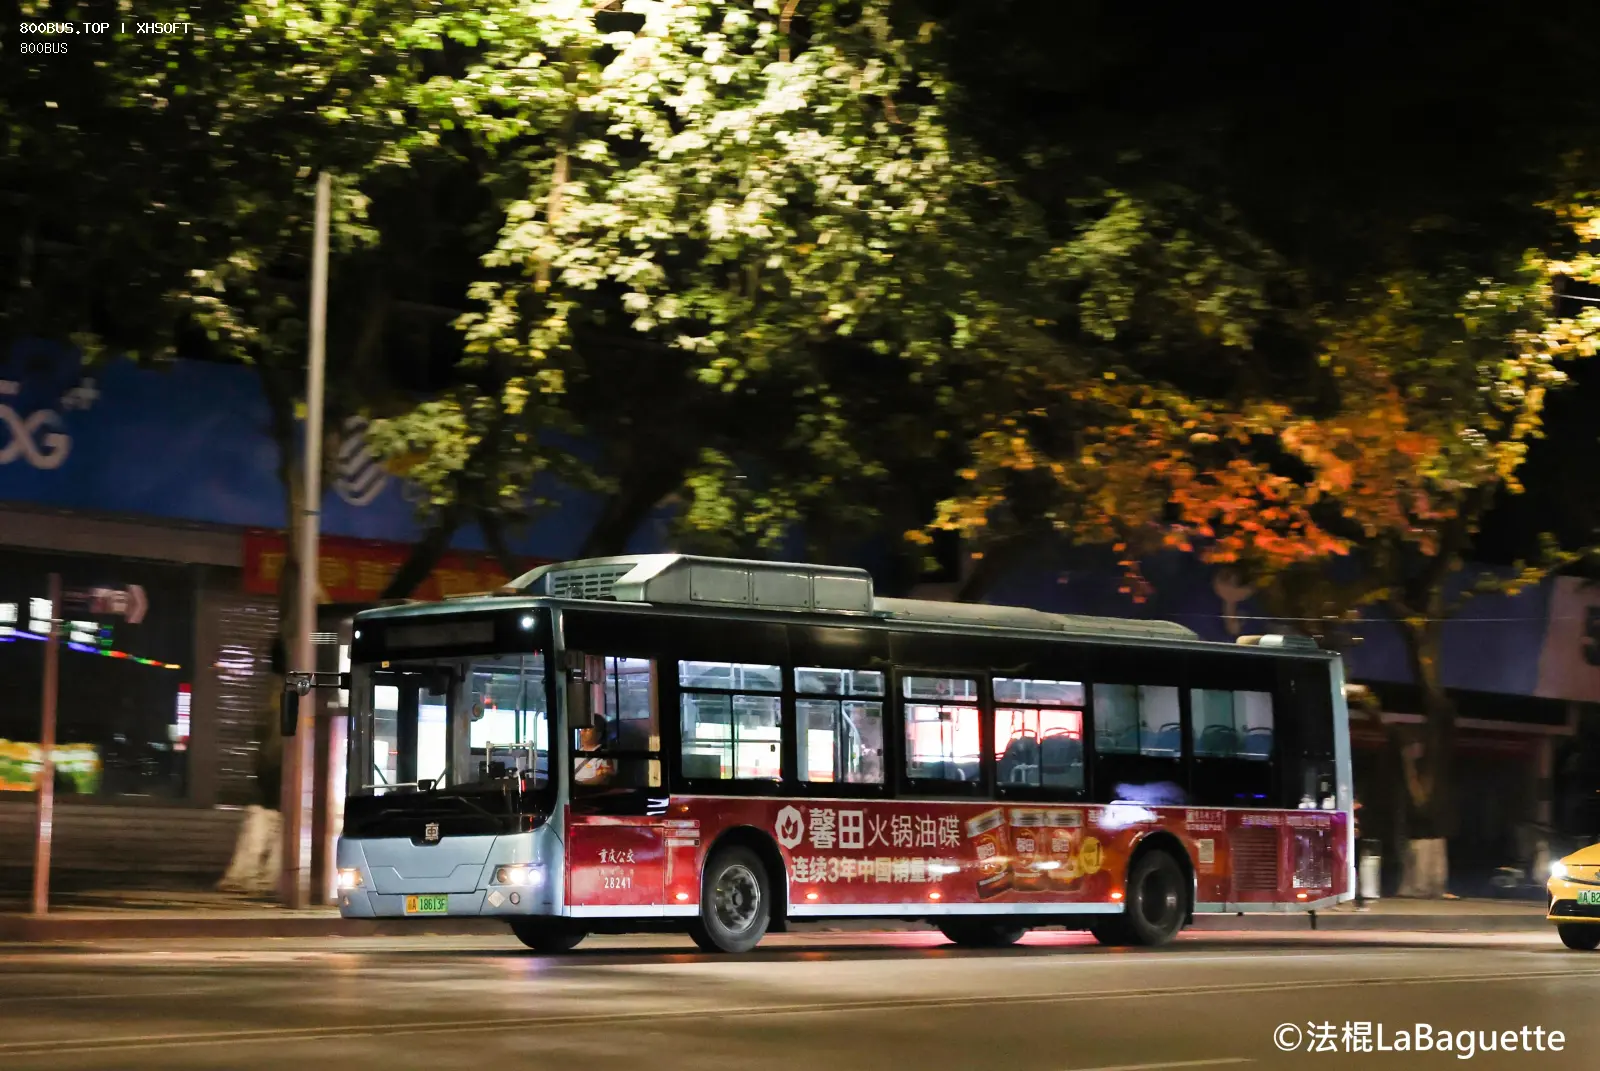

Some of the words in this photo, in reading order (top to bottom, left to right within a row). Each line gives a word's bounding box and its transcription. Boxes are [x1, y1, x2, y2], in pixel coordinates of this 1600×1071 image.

[598, 848, 636, 864] 重庆公交
[604, 876, 631, 889] 28241
